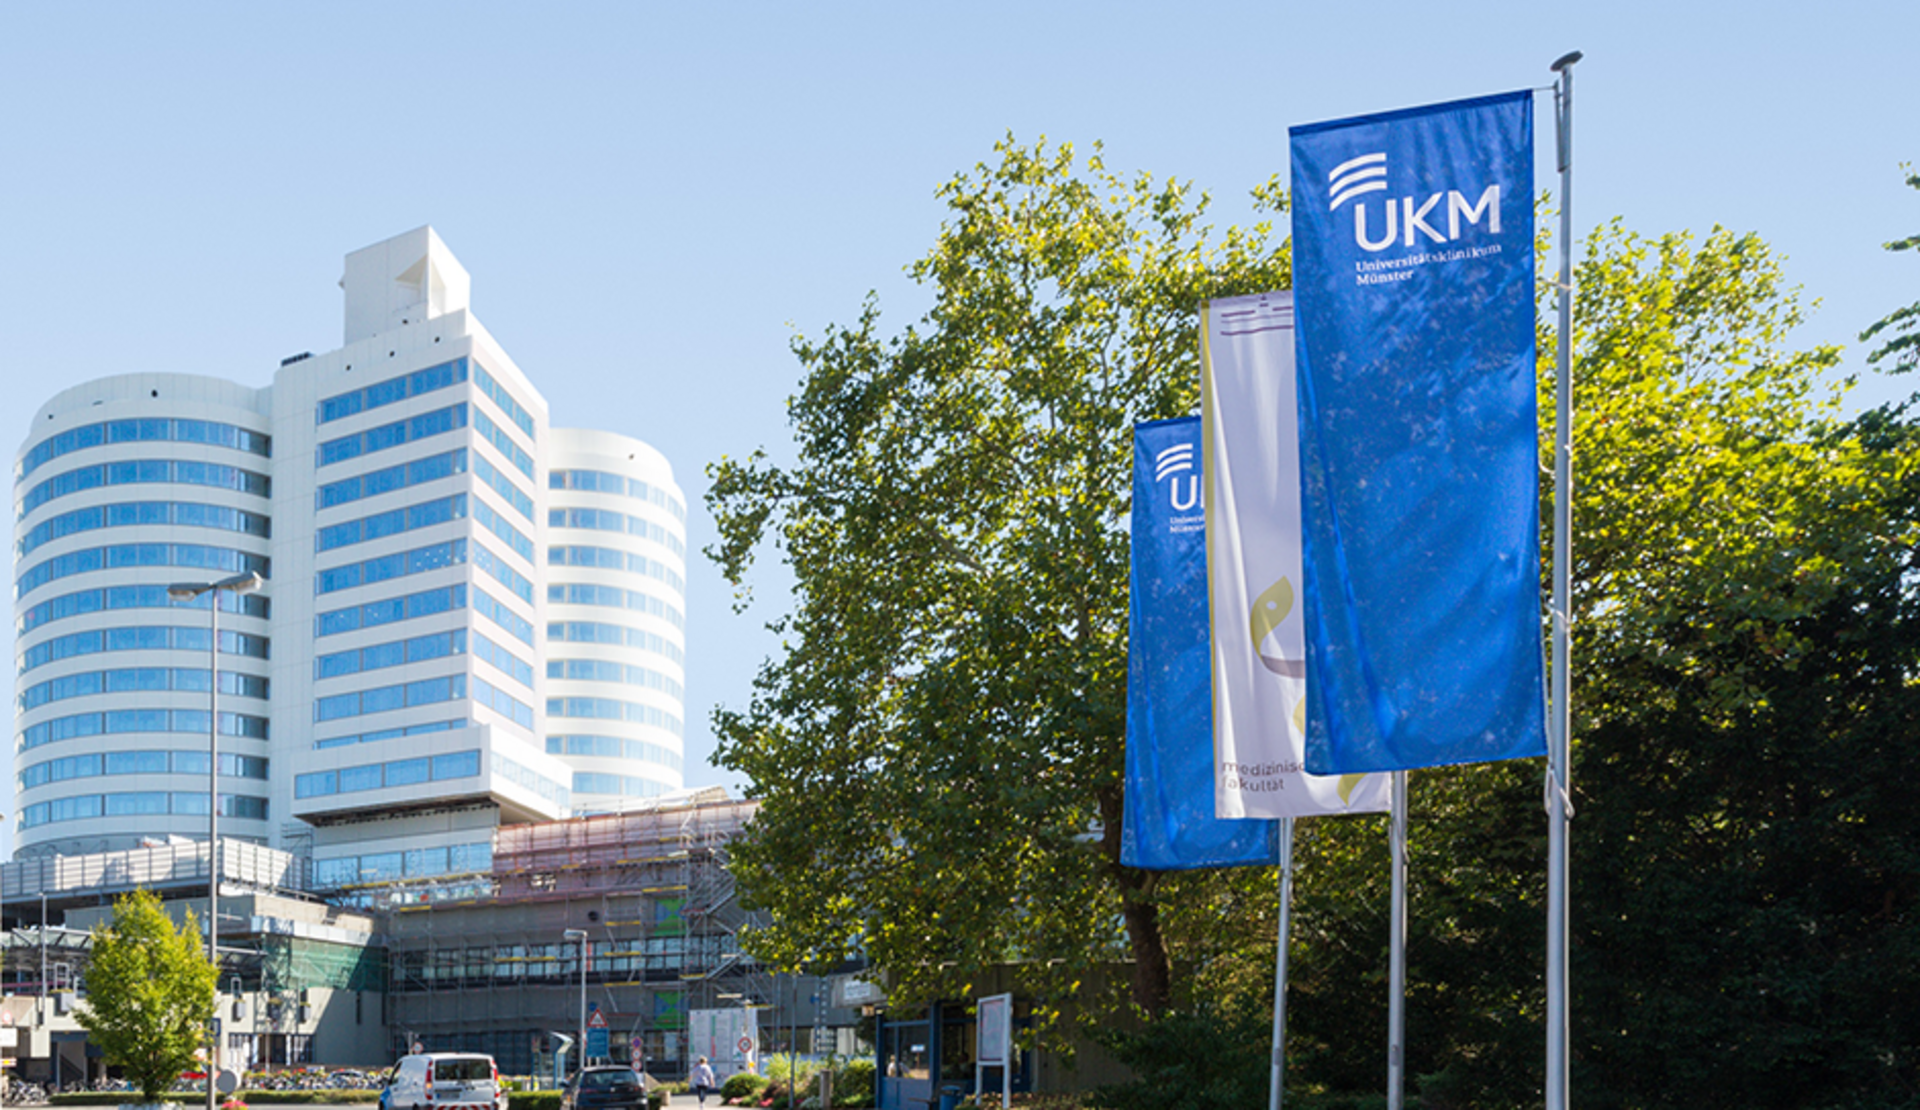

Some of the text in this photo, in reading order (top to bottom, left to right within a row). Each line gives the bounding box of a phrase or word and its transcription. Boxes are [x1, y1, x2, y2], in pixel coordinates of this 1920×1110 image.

[1355, 185, 1500, 252] UKM
[1355, 244, 1502, 273] Universitätsklinikum
[1356, 270, 1414, 286] Münster
[1171, 475, 1205, 511] U
[1222, 776, 1284, 792] fakultät
